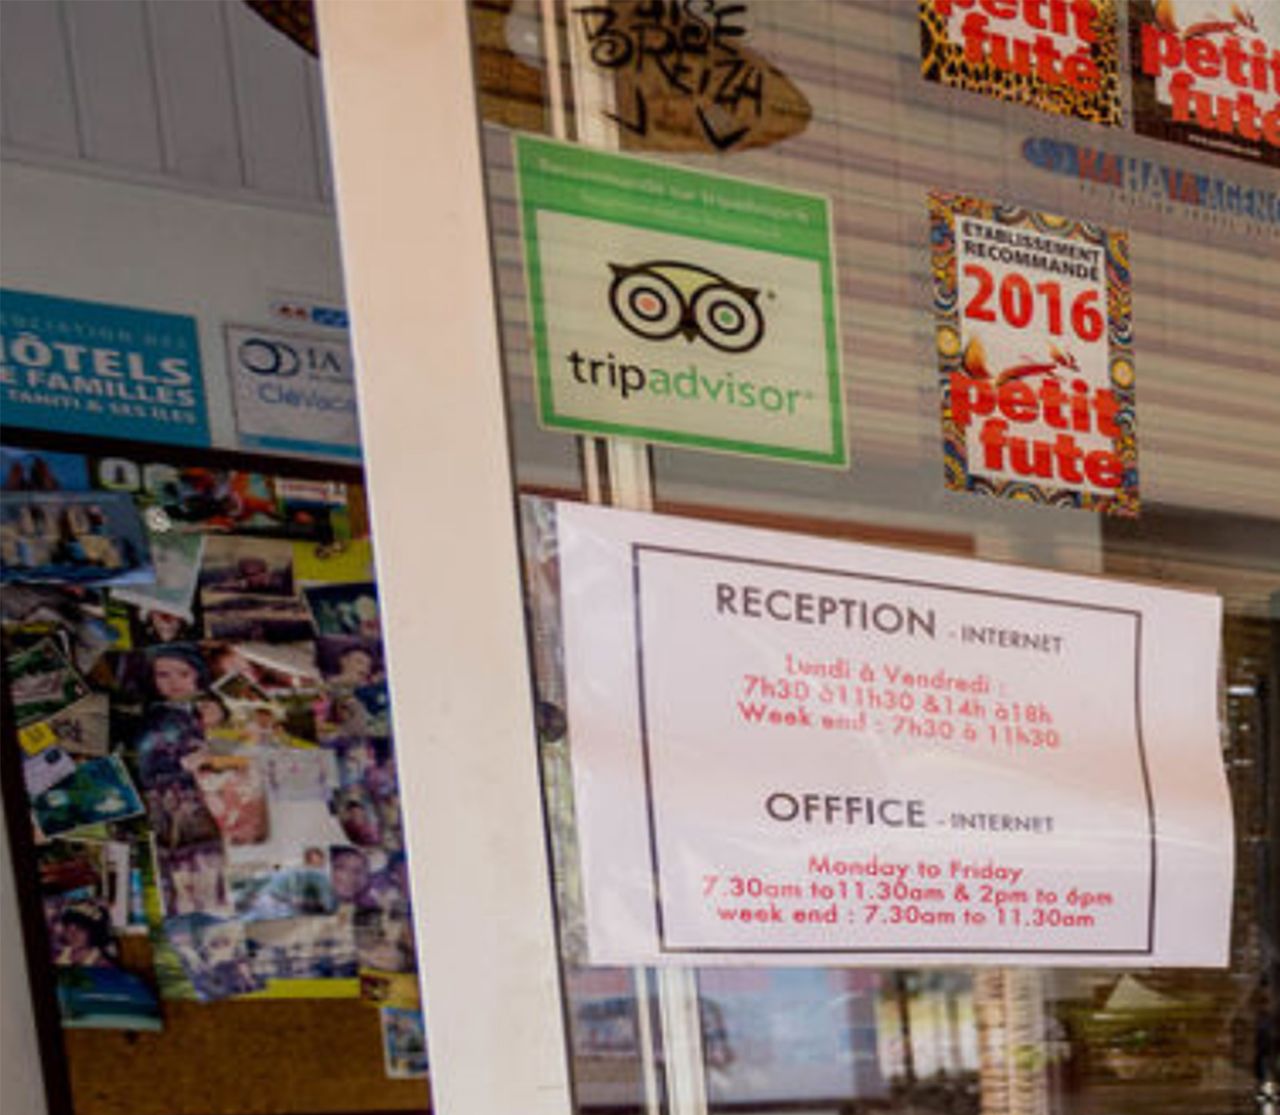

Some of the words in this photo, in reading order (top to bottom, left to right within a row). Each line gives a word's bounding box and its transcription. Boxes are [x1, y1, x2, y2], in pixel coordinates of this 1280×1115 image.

[962, 263, 1105, 343] 2016
[28, 370, 196, 408] FAMILLES
[566, 350, 804, 415] tripadvisor
[949, 370, 1122, 439] petit
[715, 583, 937, 639] RECEPTION
[961, 625, 1064, 655] INTERNET
[742, 674, 810, 701] 7h30
[785, 653, 850, 679] Lundi
[883, 664, 991, 695] Vendredi
[737, 701, 813, 728] Week
[821, 711, 867, 733] end
[892, 715, 956, 741] 7h30
[988, 722, 1063, 750] 11h30
[765, 791, 926, 829] OFFFICE
[950, 812, 1055, 835] INTERNET
[808, 855, 909, 884] Monday
[917, 859, 940, 878] to
[949, 859, 1024, 884] Friday
[716, 905, 783, 924] week
[792, 904, 838, 925] end
[864, 904, 956, 927] 7.30am
[963, 907, 987, 926] to
[995, 907, 1096, 929] 11.30am
[953, 885, 971, 903] &
[978, 884, 1030, 908] 2pm
[1035, 888, 1059, 905] to
[1065, 888, 1114, 910] 6pm
